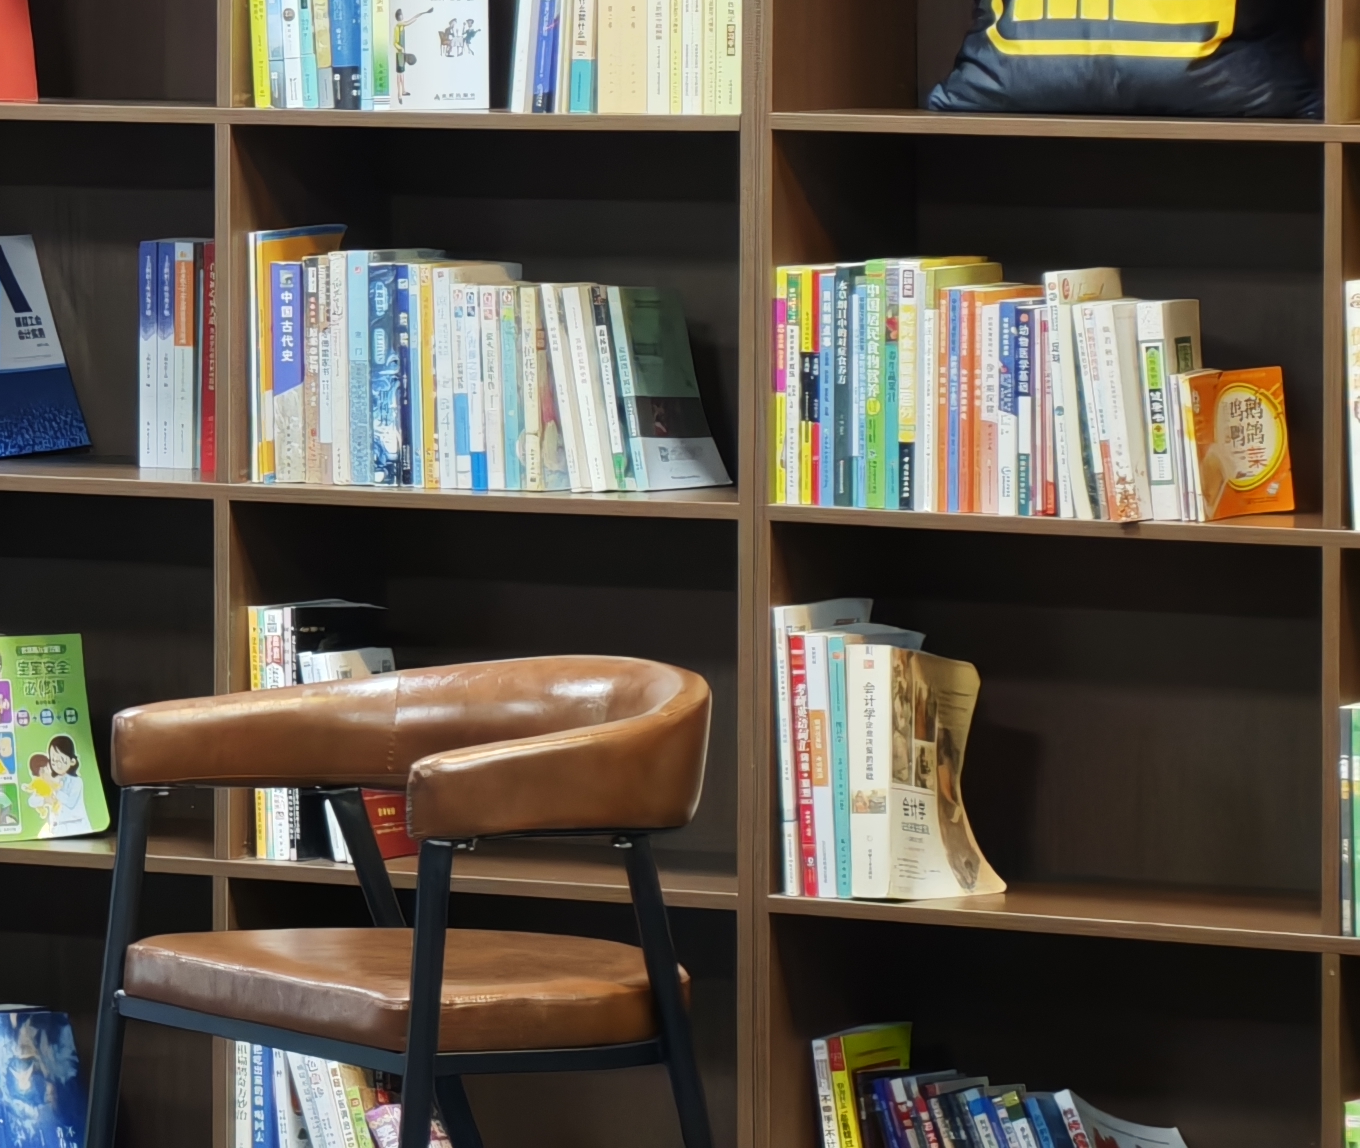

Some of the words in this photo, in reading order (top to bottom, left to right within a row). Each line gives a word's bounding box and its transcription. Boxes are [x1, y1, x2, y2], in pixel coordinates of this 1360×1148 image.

[279, 290, 295, 362] 中国古代史
[863, 681, 877, 720] 会计学
